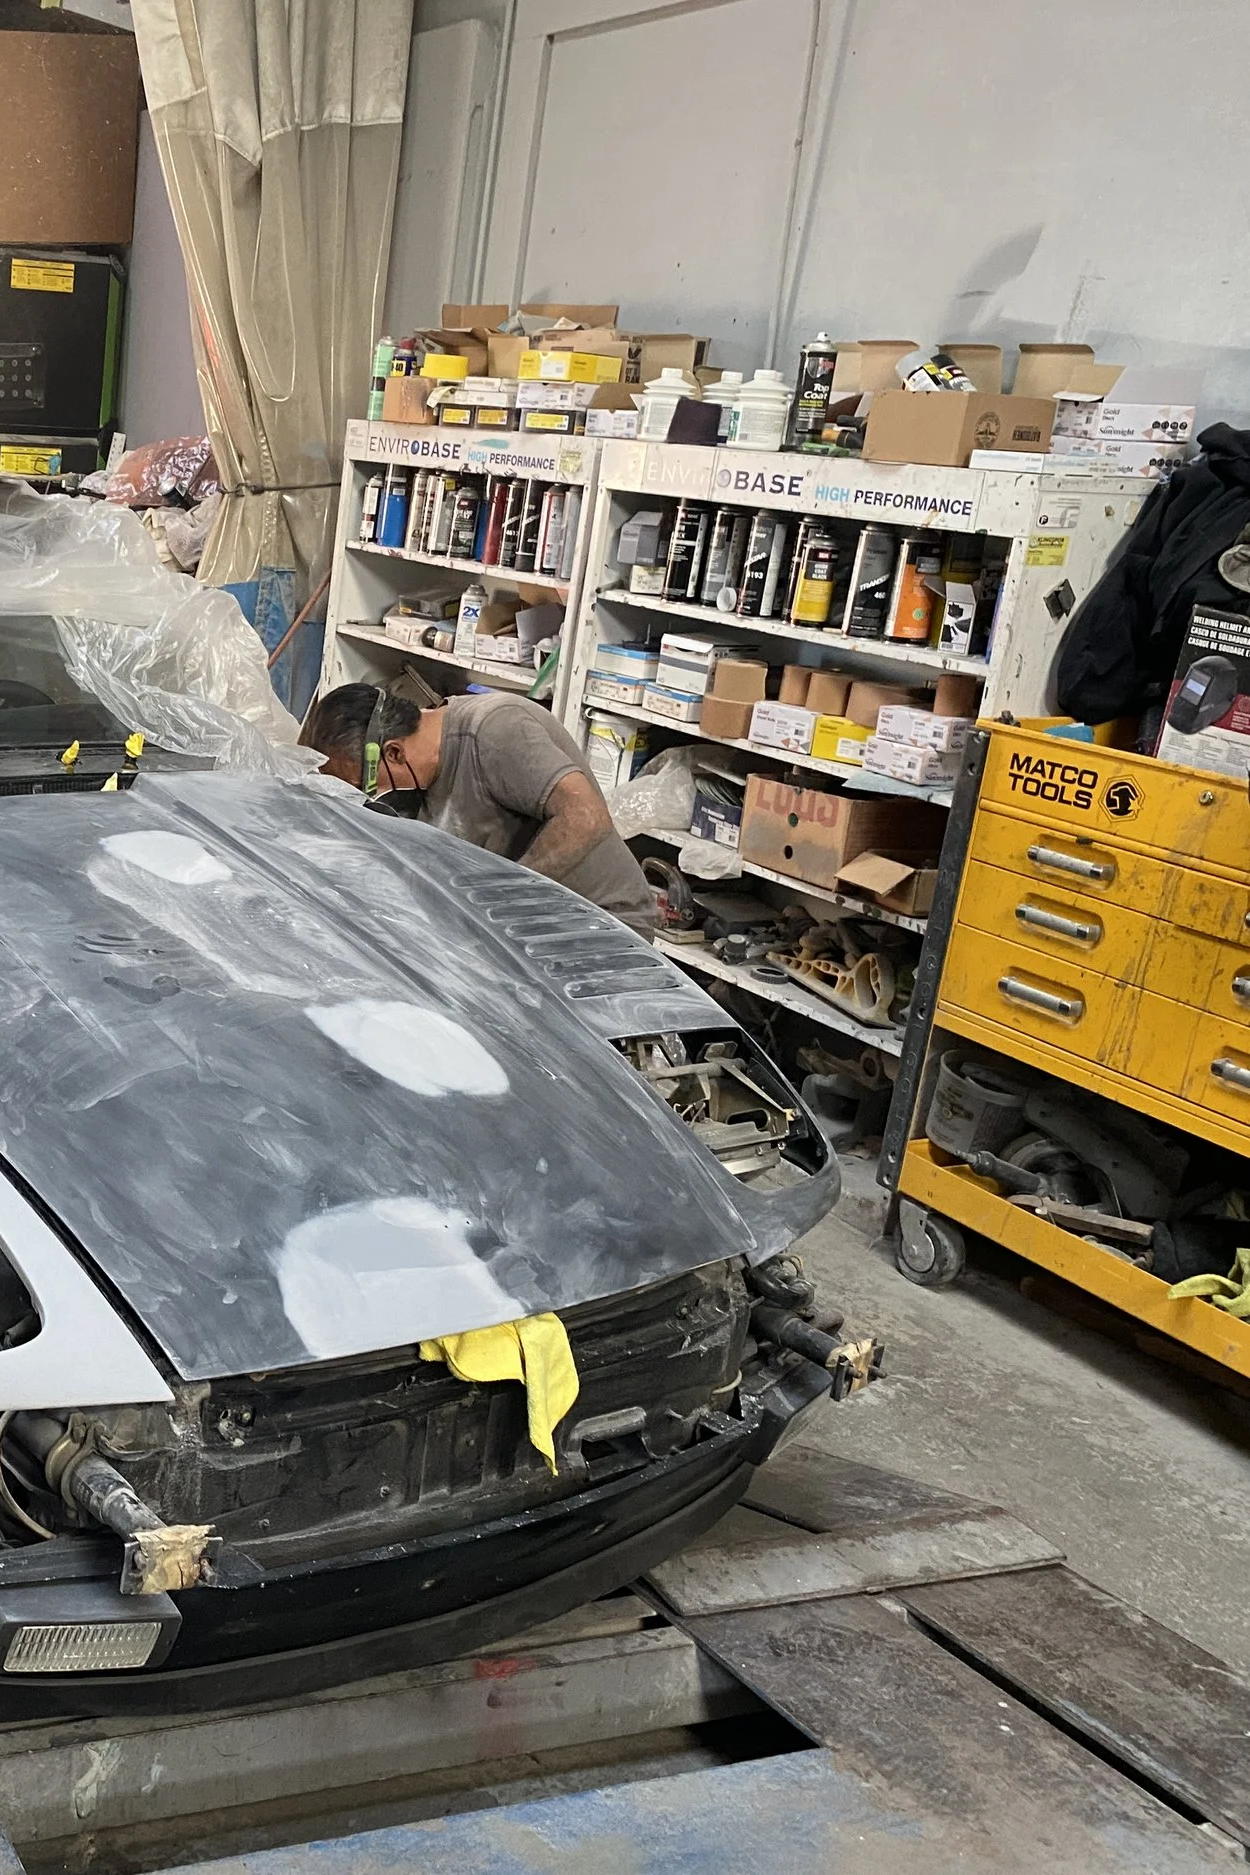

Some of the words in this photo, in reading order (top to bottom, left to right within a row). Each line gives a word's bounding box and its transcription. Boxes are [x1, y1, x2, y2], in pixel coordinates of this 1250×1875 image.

[803, 391, 828, 400] Coat
[813, 383, 830, 393] Top
[369, 436, 462, 460] ENVIROBASE
[467, 450, 488, 464] HIGH
[489, 452, 556, 471] PERFORMANCE
[814, 484, 850, 502] HIGH
[854, 489, 974, 516] PERFORMANCE
[1190, 626, 1210, 637] CASCO
[1209, 630, 1218, 639] DE
[1193, 615, 1220, 628] WELDING
[1219, 621, 1243, 633] HELMET
[1209, 641, 1218, 650] DE
[1010, 752, 1099, 790] MATCO
[1008, 771, 1093, 810] TOOLS
